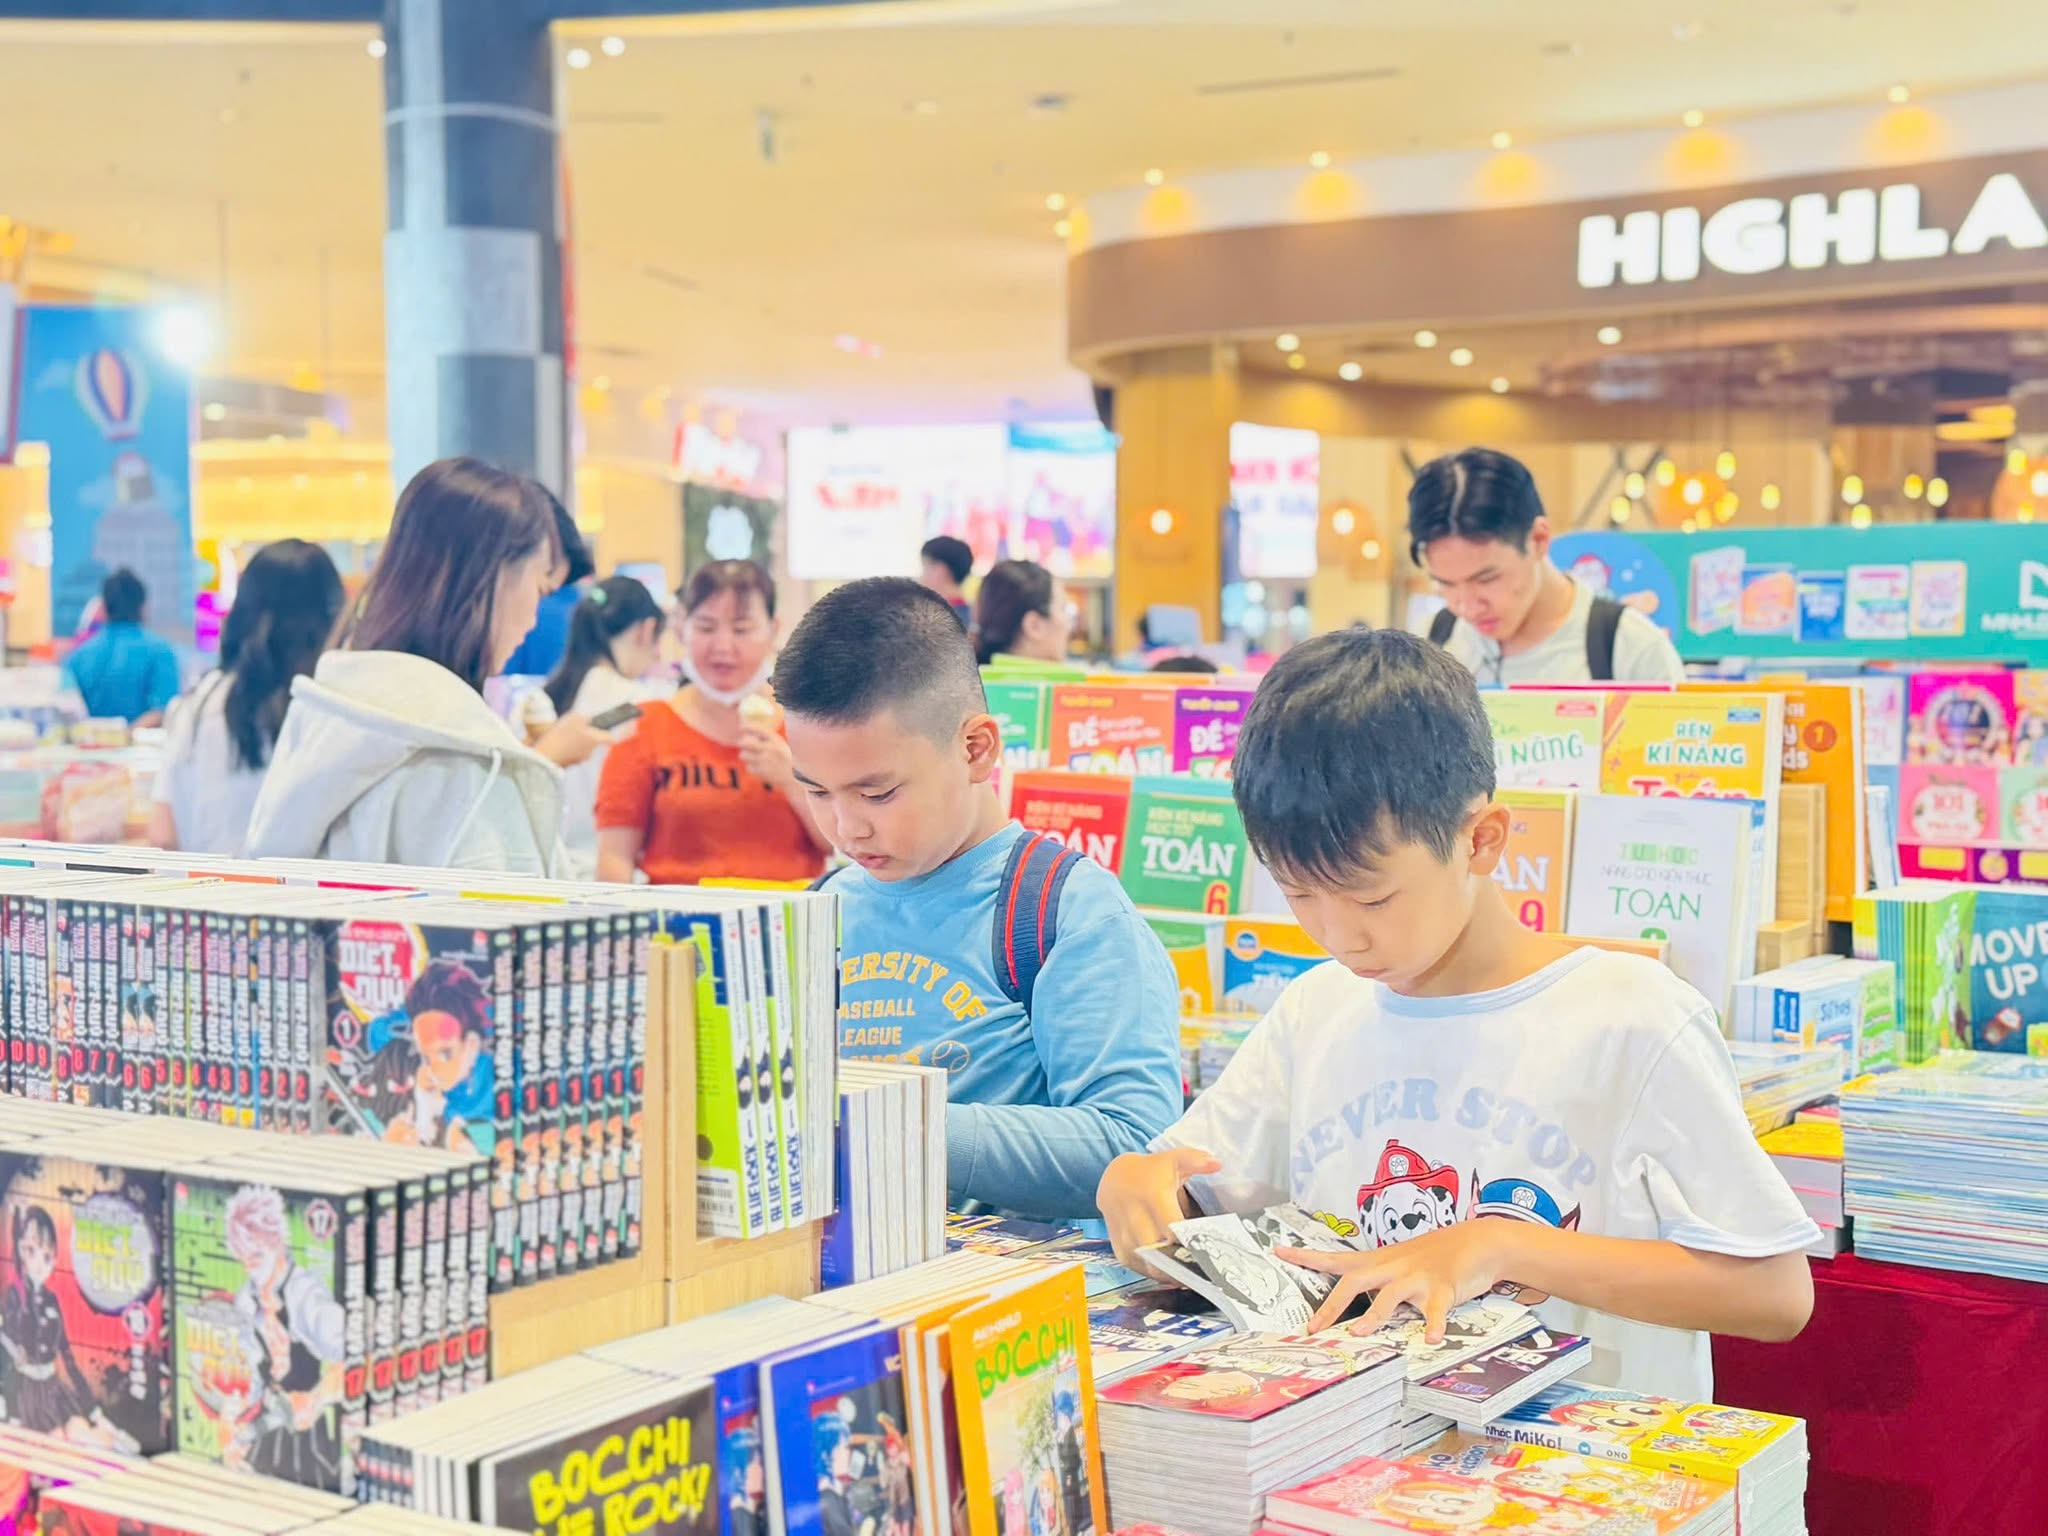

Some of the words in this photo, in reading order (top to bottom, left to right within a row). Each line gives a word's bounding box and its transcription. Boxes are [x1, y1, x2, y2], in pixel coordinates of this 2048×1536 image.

[1813, 726, 1825, 745] 1
[1140, 836, 1237, 877] TOÁN
[1206, 881, 1230, 915] 6
[942, 981, 988, 1021] OF
[1984, 962, 2039, 1000] UP
[838, 998, 916, 1020] ASEBALL
[1291, 1078, 1440, 1194] NEVER
[1455, 1086, 1597, 1191] STOP
[974, 1317, 1075, 1400] BOCCHI
[529, 1416, 692, 1525] BOCCHI
[1606, 1449, 1628, 1460] ONO
[603, 1462, 712, 1536] ROCK!
